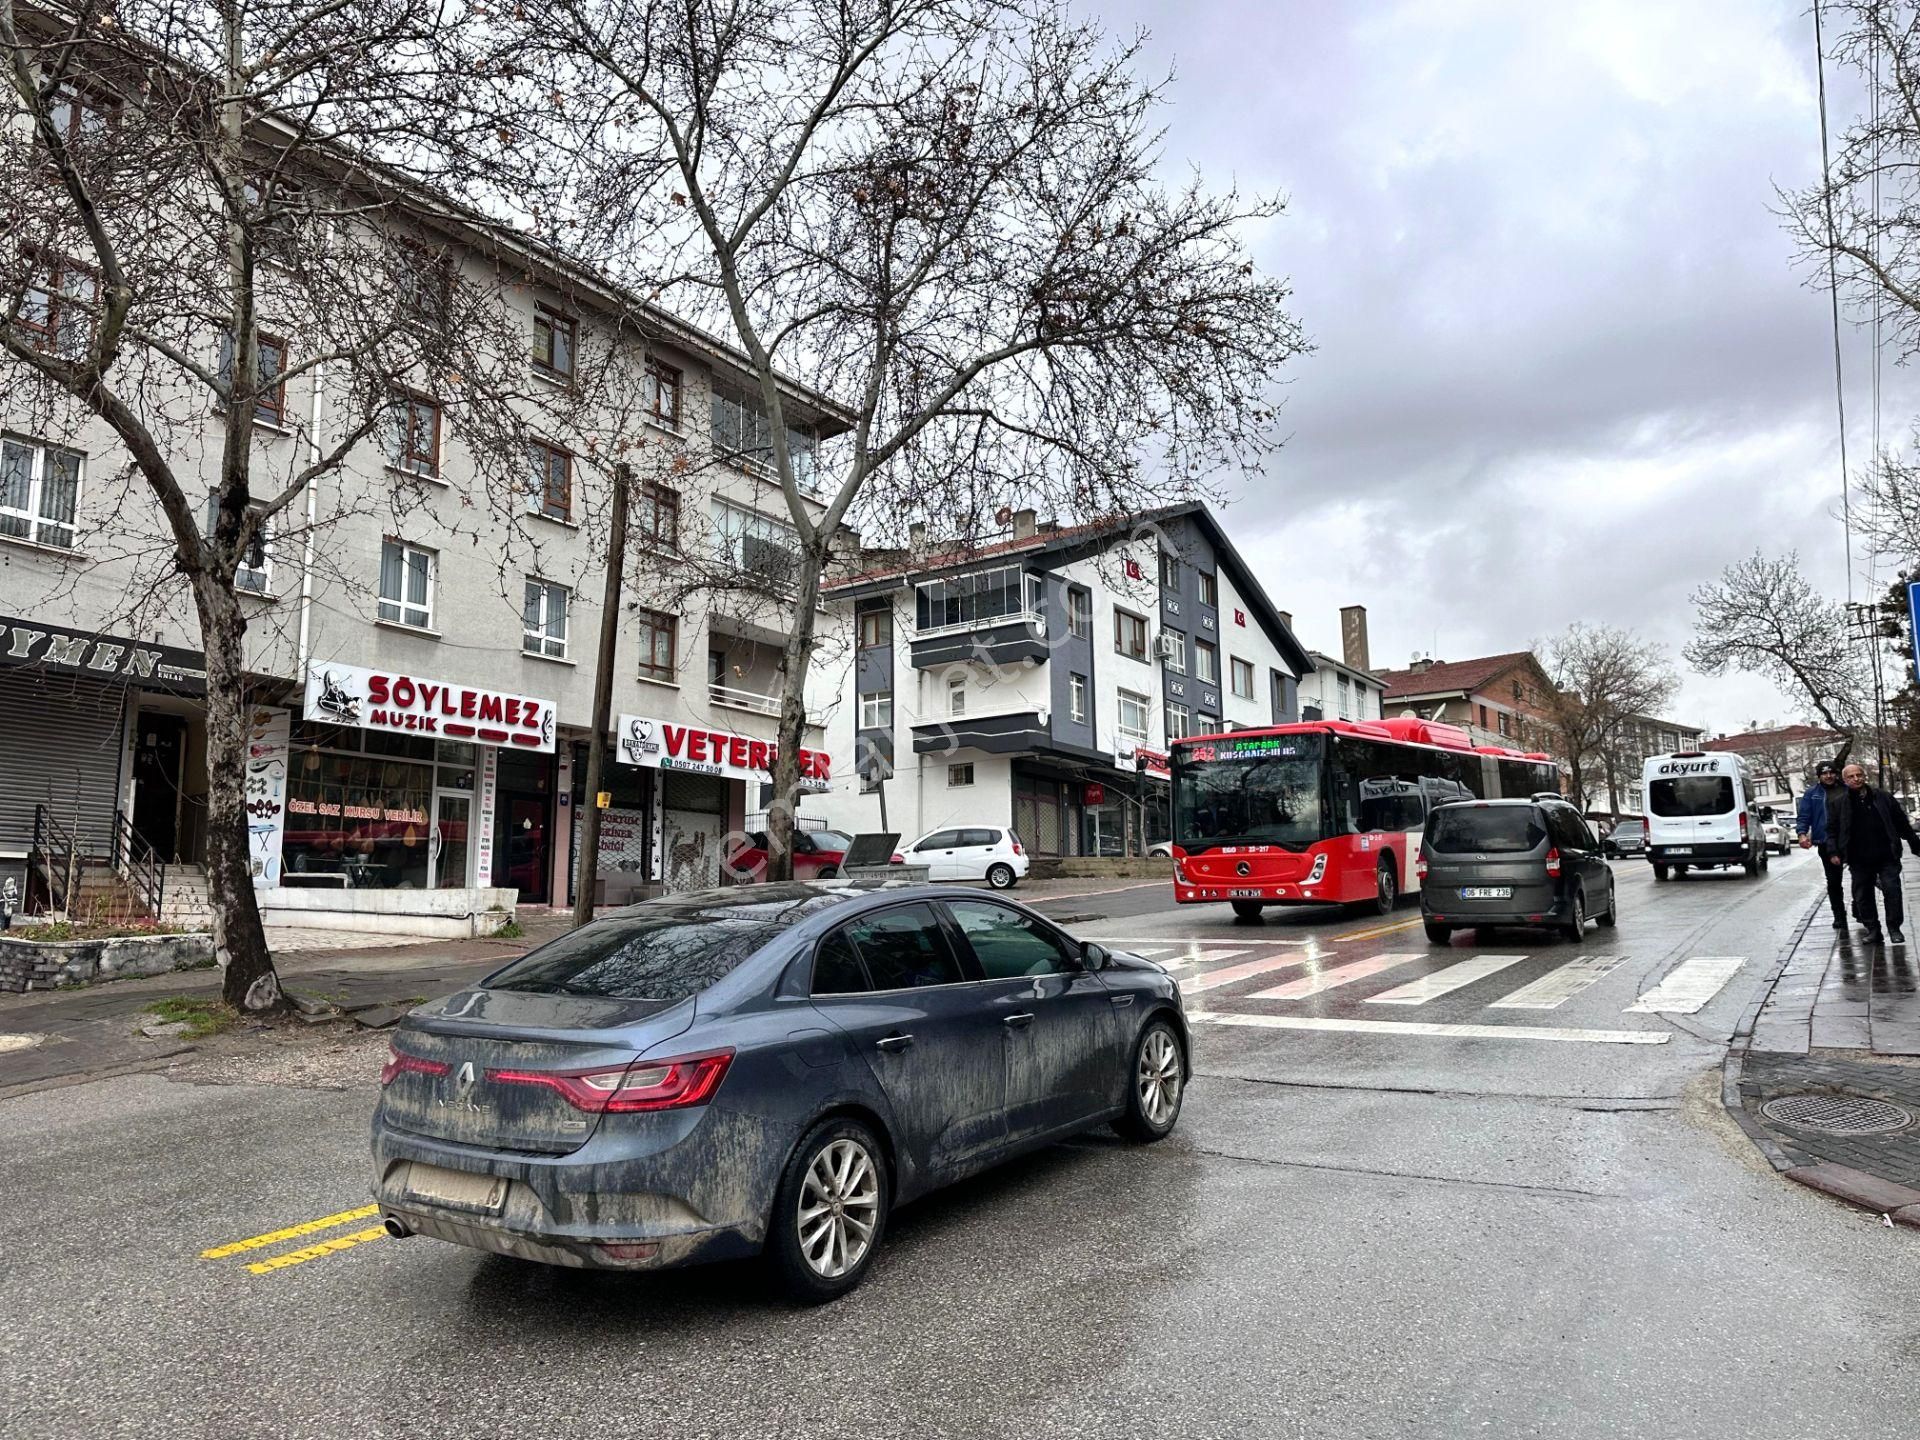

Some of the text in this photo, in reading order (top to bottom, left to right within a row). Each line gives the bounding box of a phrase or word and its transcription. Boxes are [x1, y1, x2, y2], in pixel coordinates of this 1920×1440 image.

[0, 625, 162, 677] YMEN
[368, 676, 540, 728] SÖYLEMEZ
[663, 725, 830, 780] VETERİER
[1192, 747, 1216, 761] 252
[674, 760, 691, 769] 0507
[692, 763, 704, 771] 247
[1659, 760, 1718, 775] akyurt
[288, 798, 422, 823] ÖZEL SAZ KURSU VERİLİR
[1479, 888, 1492, 897] FRE
[438, 1099, 491, 1114] MEGANE
